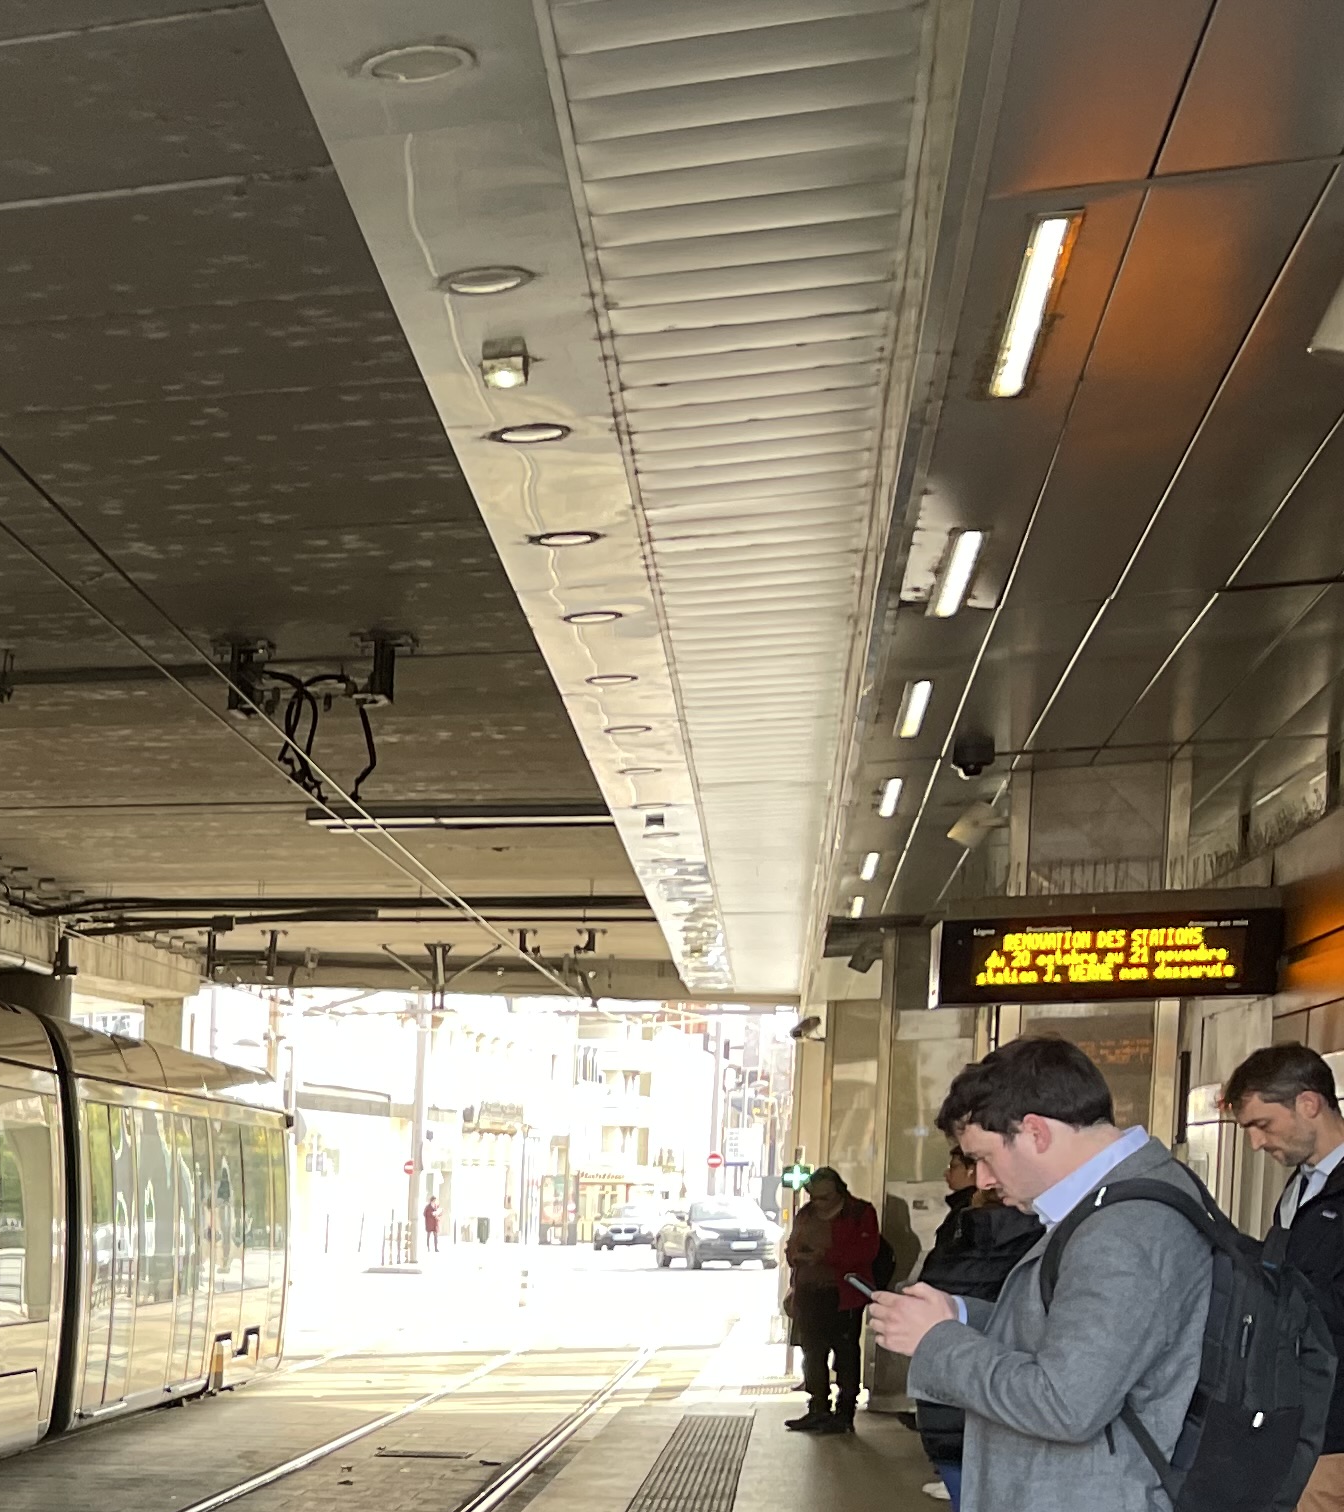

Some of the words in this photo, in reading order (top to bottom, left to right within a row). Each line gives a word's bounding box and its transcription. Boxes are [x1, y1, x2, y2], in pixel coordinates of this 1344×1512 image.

[1003, 931, 1091, 951] RENOVATION
[1096, 930, 1126, 949] DES
[1131, 927, 1203, 948] STATIONS
[985, 950, 1006, 968] du
[1011, 950, 1031, 967] 20
[1035, 948, 1098, 966] octobre
[1104, 952, 1124, 964] au
[1128, 946, 1149, 964] 21
[1155, 944, 1228, 962] novembre
[976, 967, 1038, 986] station
[1068, 963, 1113, 982] VERNE
[1119, 967, 1148, 981] non
[1153, 961, 1235, 979] desservie
